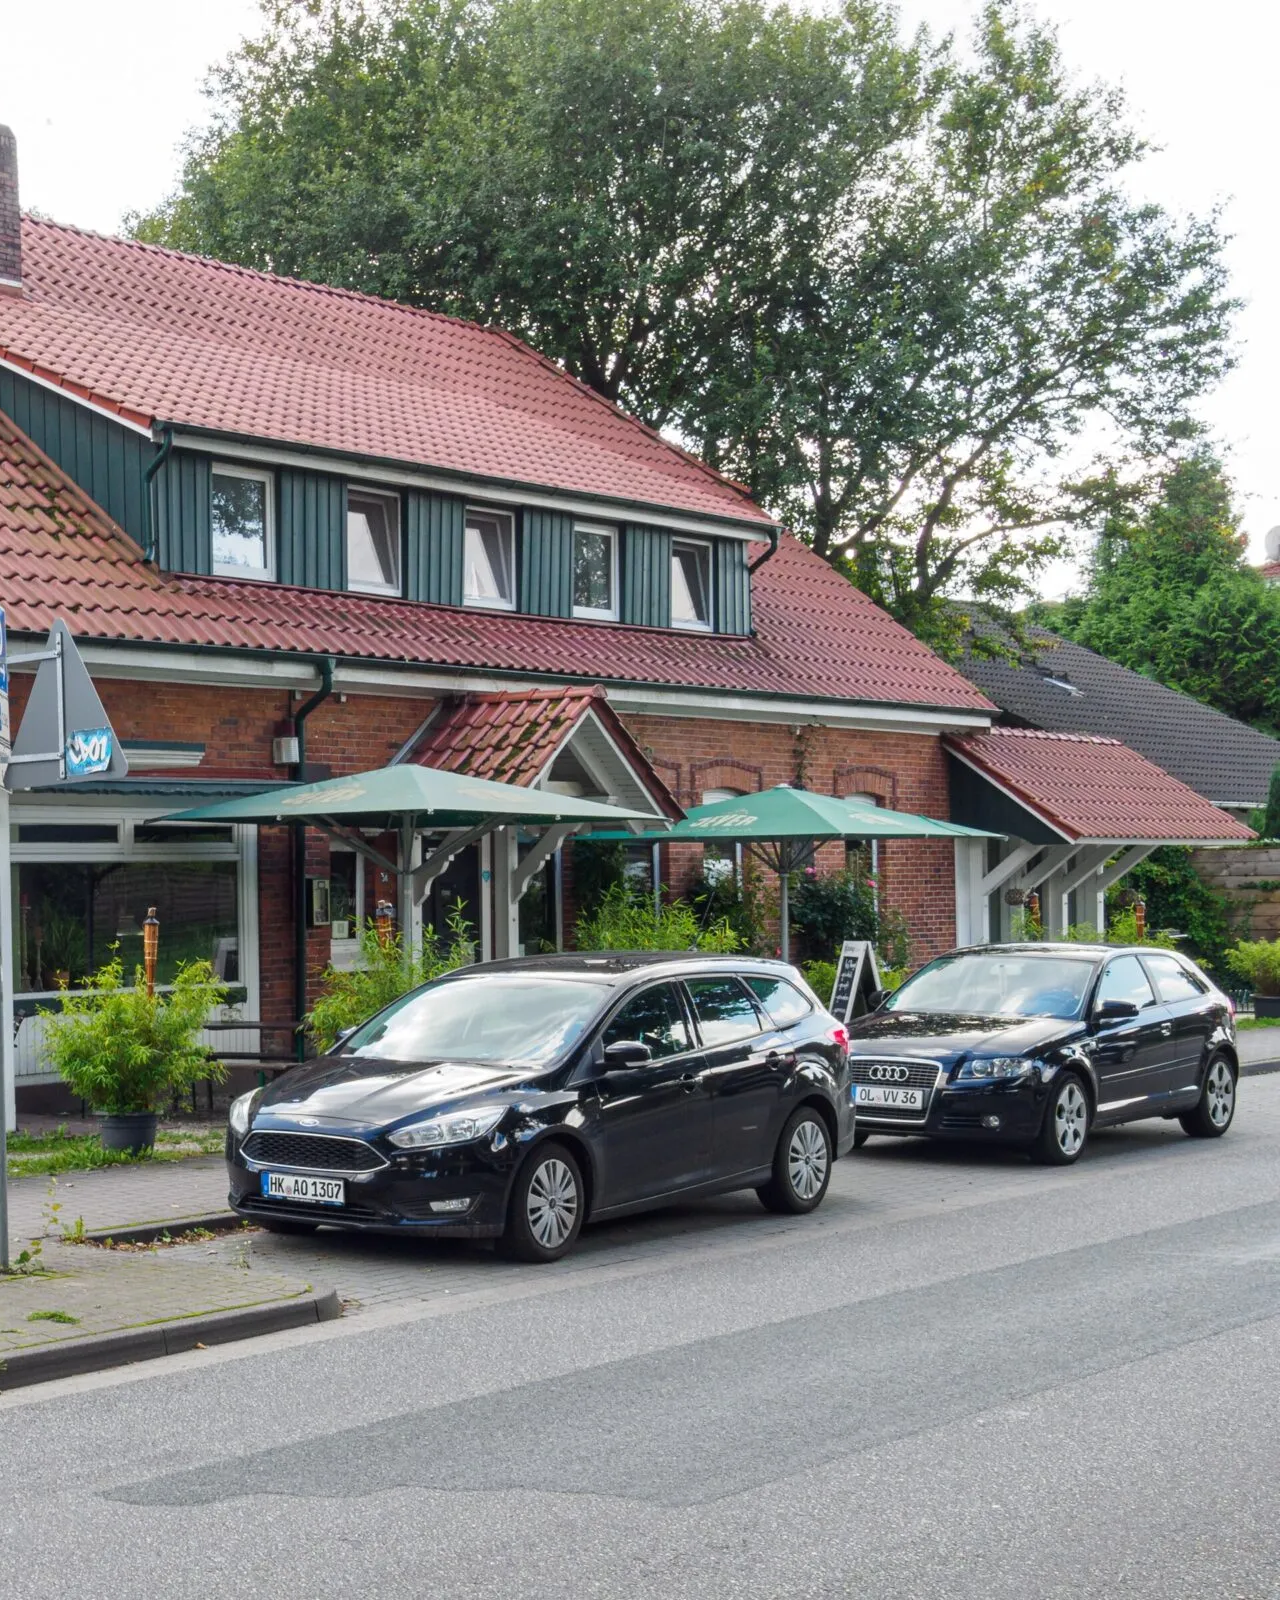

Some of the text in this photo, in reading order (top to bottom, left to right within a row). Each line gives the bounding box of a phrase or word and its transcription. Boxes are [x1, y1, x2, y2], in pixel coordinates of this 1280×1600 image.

[860, 1088, 917, 1105] OL VV 36
[270, 1176, 342, 1200] HK AO 1307
